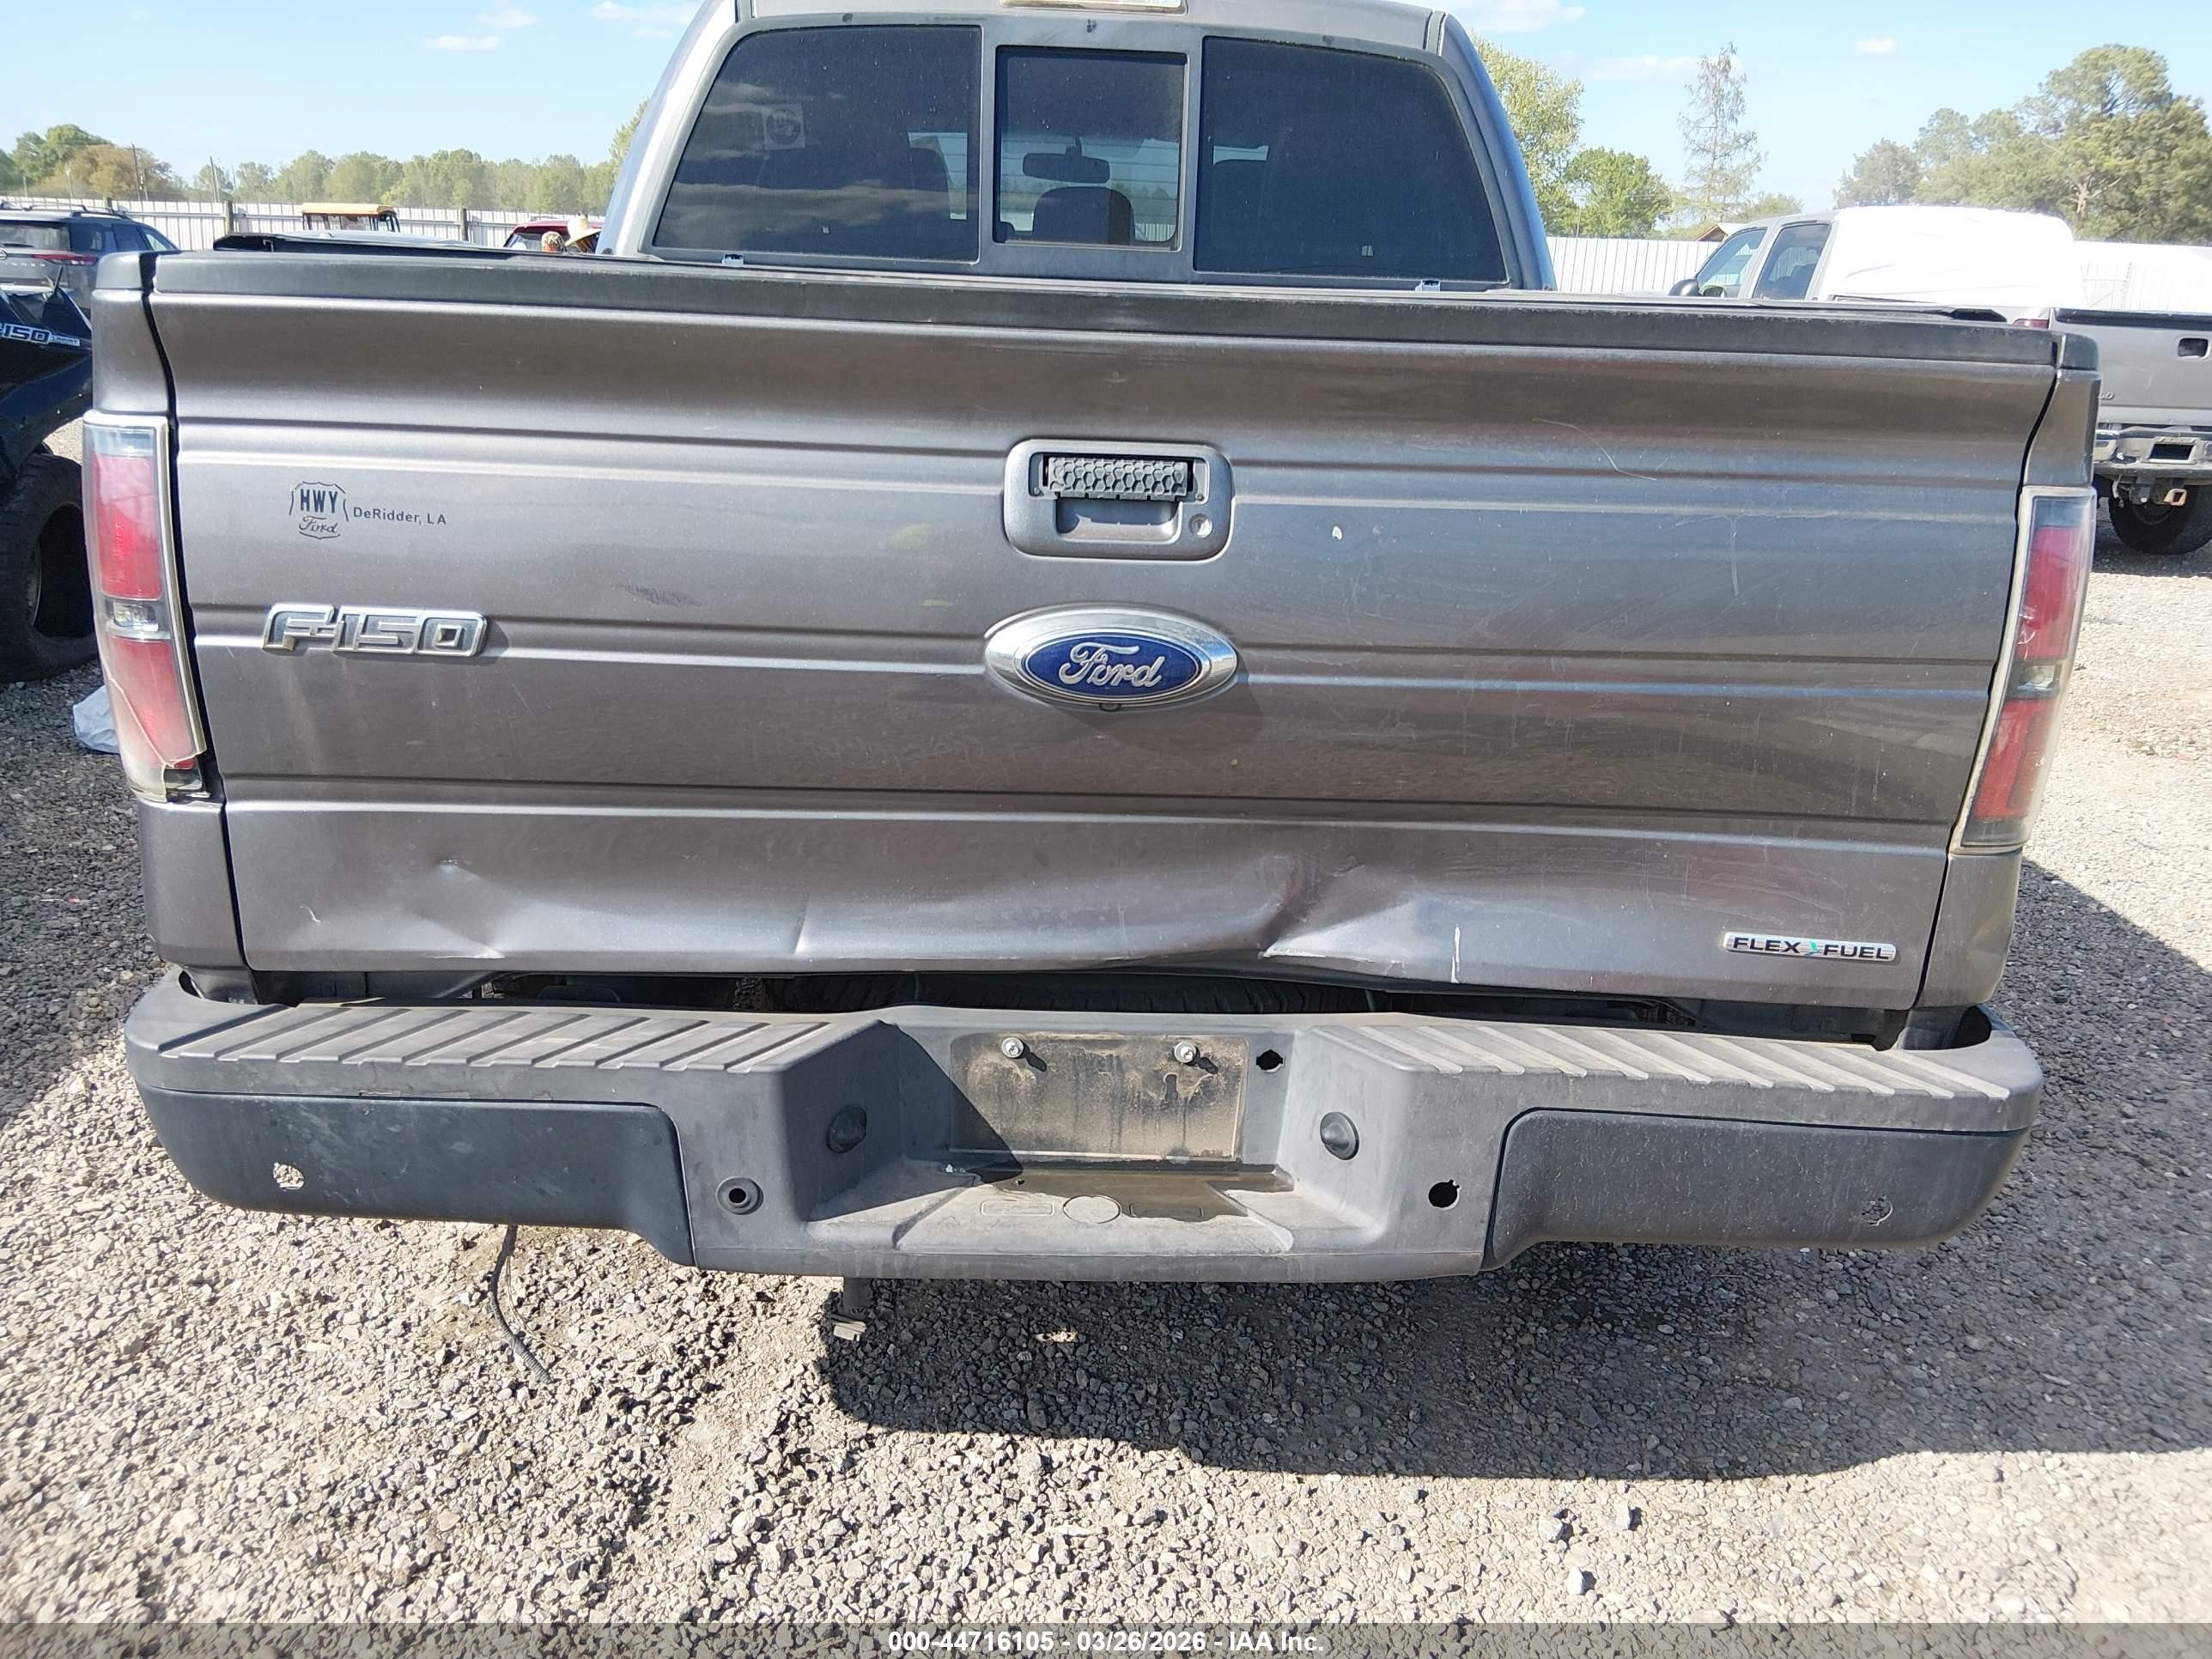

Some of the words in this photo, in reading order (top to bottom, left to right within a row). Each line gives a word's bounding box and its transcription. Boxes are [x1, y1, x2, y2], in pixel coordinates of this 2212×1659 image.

[301, 489, 338, 514] HWY
[299, 515, 339, 533] Ford
[353, 507, 422, 526] DeRidder,
[427, 514, 447, 526] LA
[262, 604, 488, 657] F-150
[1058, 642, 1166, 688] Ford
[1733, 937, 1802, 953] FLEX
[1822, 944, 1889, 960] FUEL
